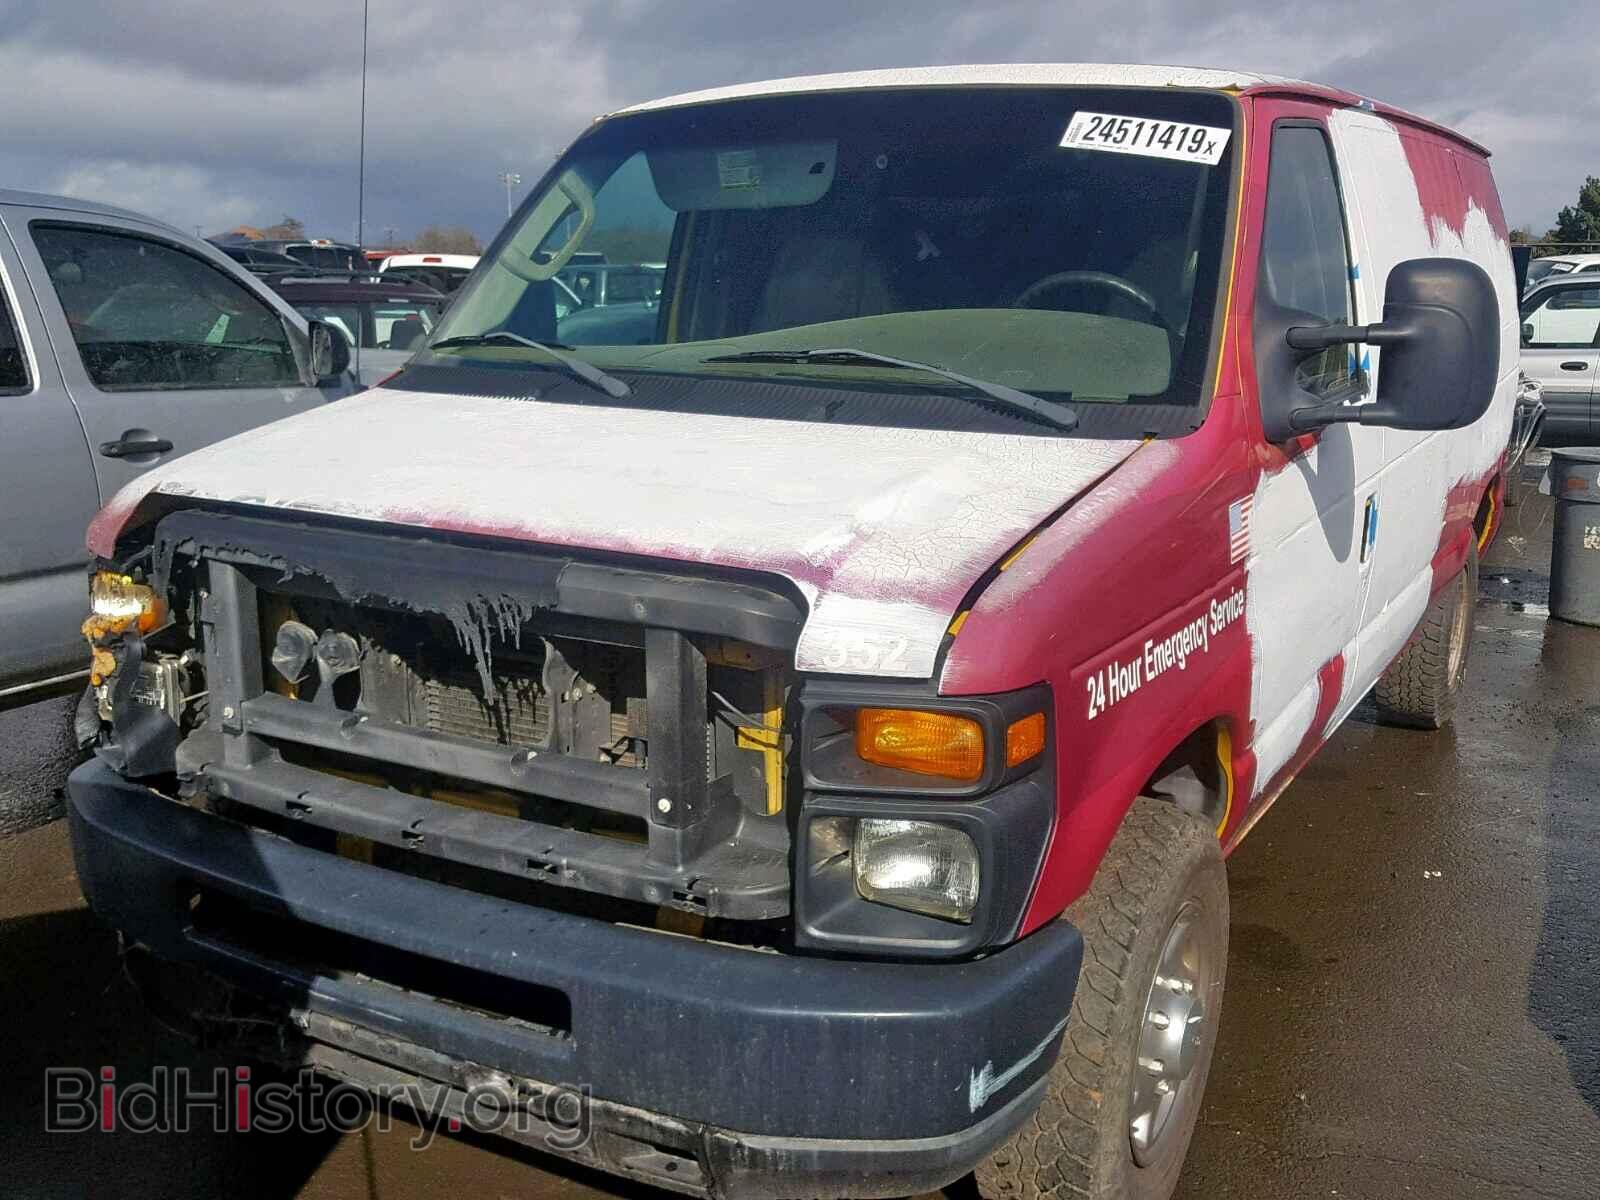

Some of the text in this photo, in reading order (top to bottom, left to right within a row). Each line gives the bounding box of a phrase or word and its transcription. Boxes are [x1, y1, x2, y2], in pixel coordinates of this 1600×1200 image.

[1087, 586, 1244, 720] 24 Hour Emergency Service
